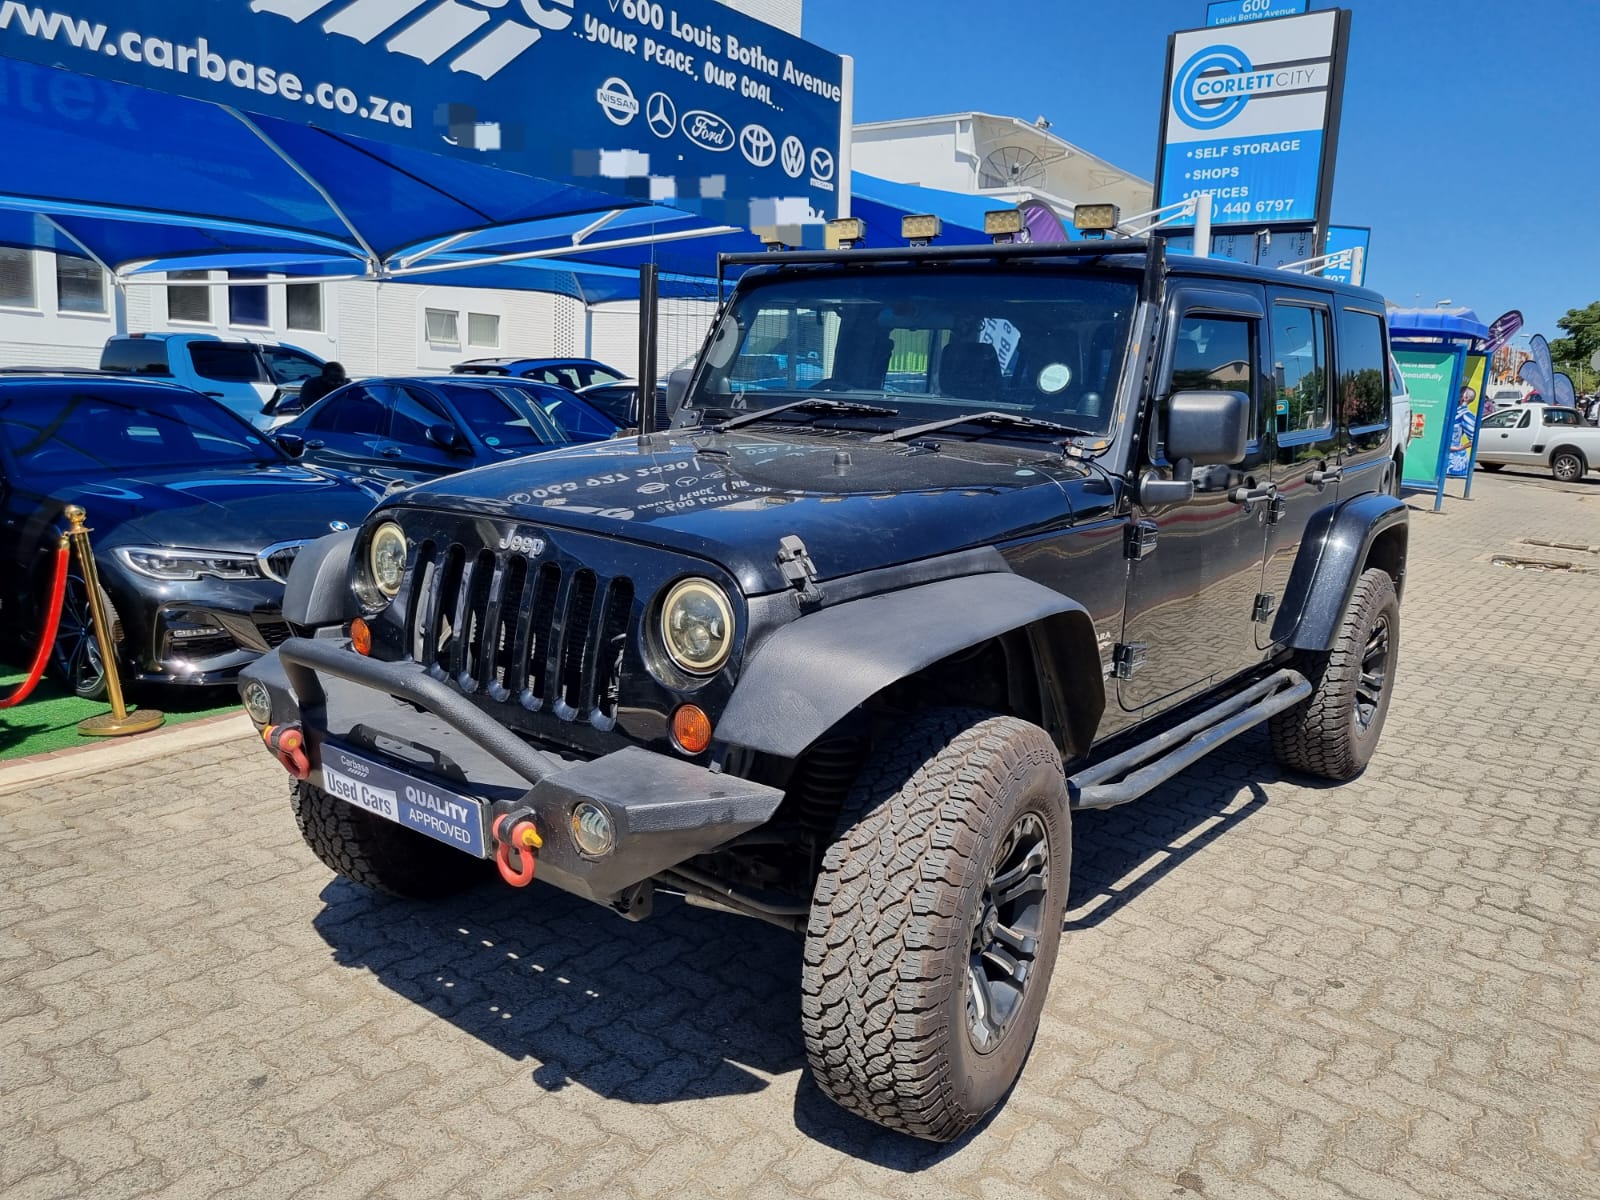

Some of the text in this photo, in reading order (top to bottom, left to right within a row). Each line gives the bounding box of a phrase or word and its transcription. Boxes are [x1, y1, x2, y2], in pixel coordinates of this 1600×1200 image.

[1215, 7, 1296, 25] Louis Botha Avenue
[1242, 0, 1270, 13] 600
[0, 0, 413, 129] ww.carbase.co.za
[622, 0, 664, 31] 600
[671, 10, 722, 55] Louis
[727, 34, 779, 78] Botha
[782, 59, 842, 103] Avenue
[704, 61, 737, 92] OUR
[599, 92, 638, 112] NISSAN
[691, 114, 727, 146] Ford
[1195, 139, 1301, 159] SELF STORAGE
[1193, 166, 1239, 180] SHOPS
[1222, 201, 1251, 215] 440
[1255, 199, 1295, 213] 6797
[499, 528, 545, 559] Jeep
[340, 755, 370, 774] Carbase
[327, 772, 392, 816] Used Cars
[405, 786, 468, 824] QUALITY
[409, 808, 472, 844] APPROVED
